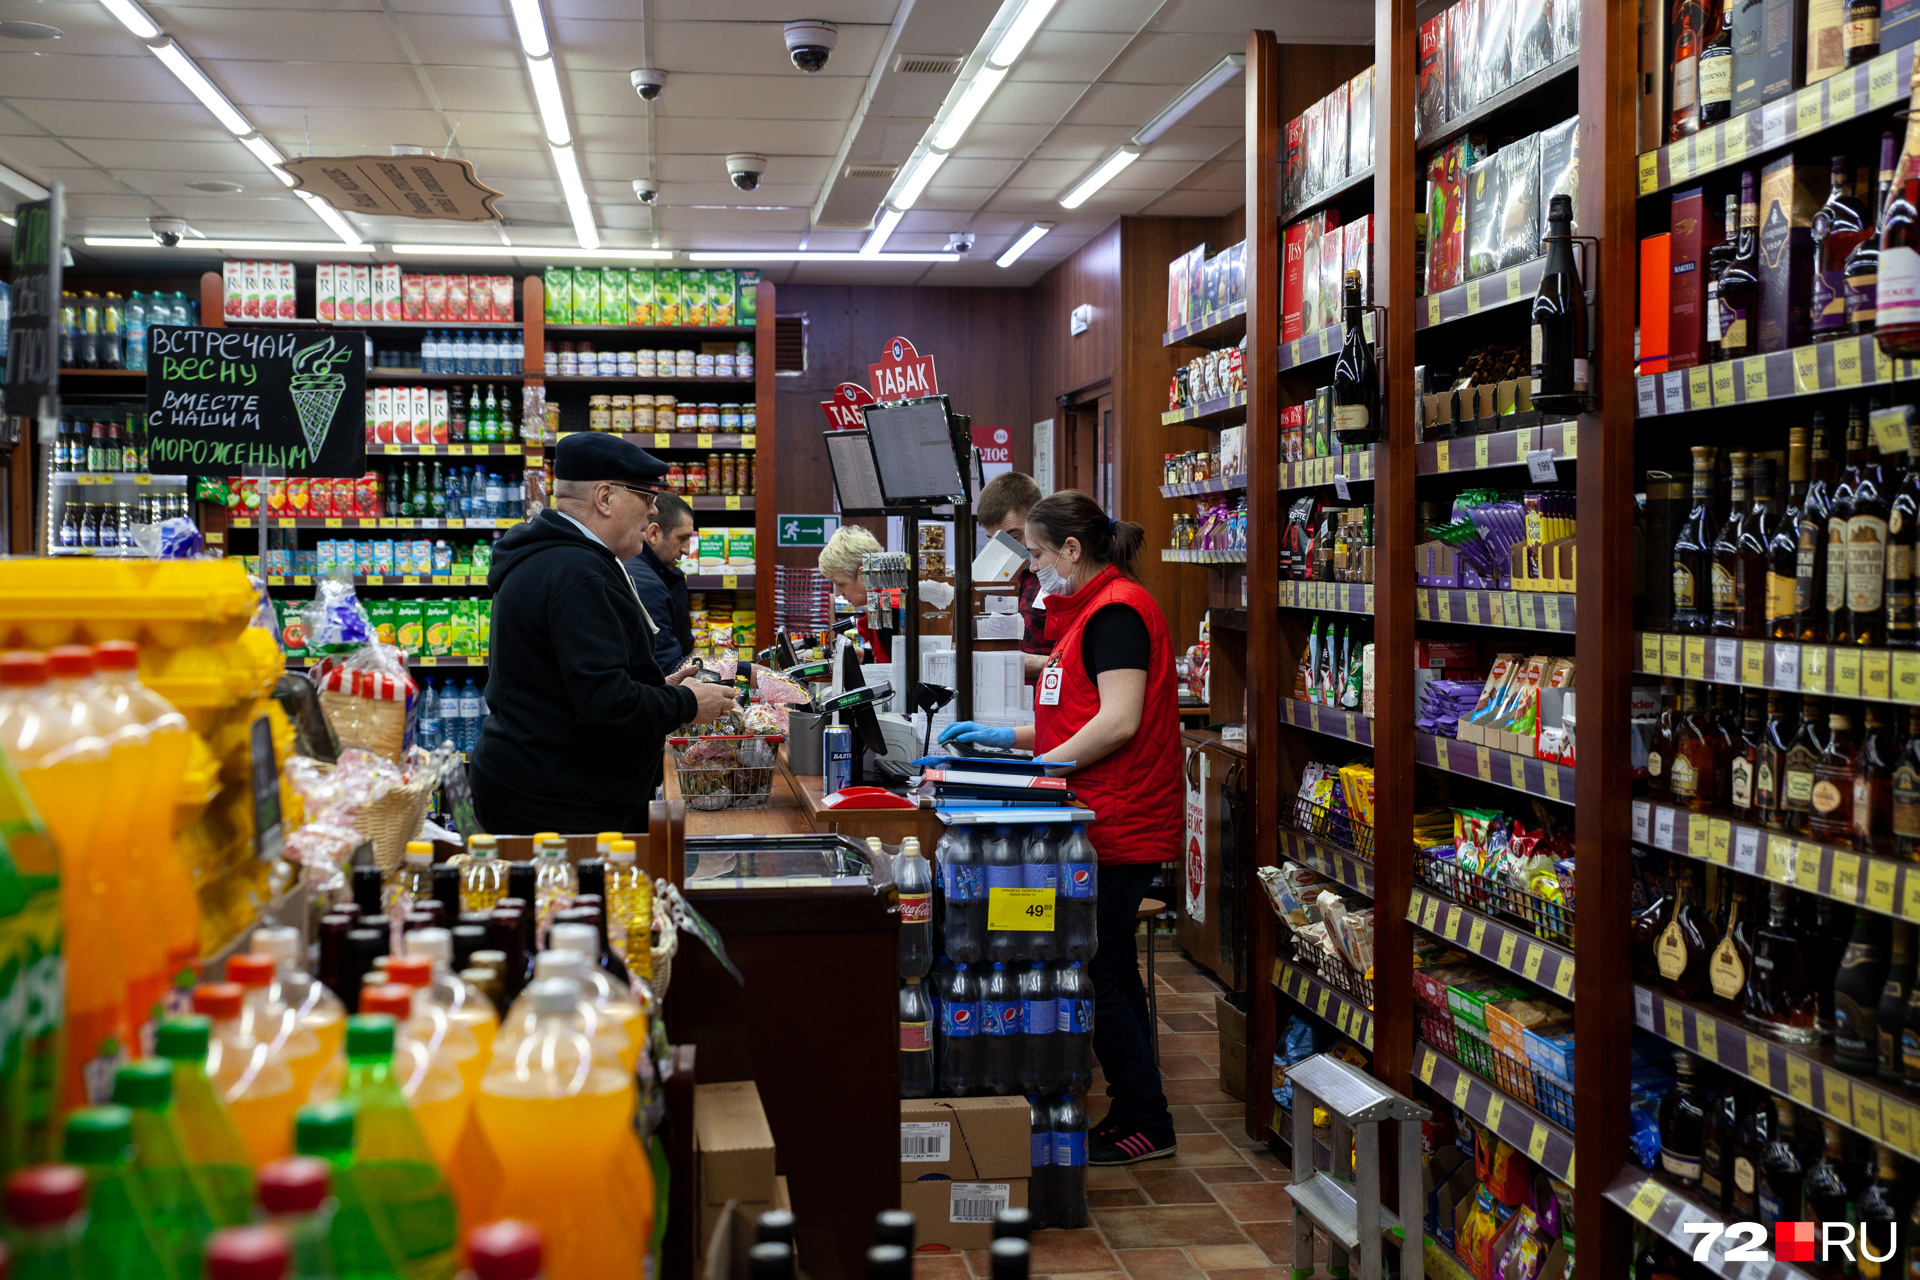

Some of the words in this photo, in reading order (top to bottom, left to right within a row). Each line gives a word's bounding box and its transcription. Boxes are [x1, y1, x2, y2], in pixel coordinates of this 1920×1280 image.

[1423, 26, 1437, 53] TESS
[1288, 126, 1300, 145] TESS
[1288, 238, 1302, 263] TESS
[1673, 262, 1695, 274] MARTELL
[875, 363, 930, 396] ТАБАК
[162, 390, 259, 411] ВМЕСТЕ
[149, 410, 163, 426] С
[171, 411, 260, 430] НАШИМ
[830, 402, 865, 427] ТАБ
[151, 436, 307, 470] МОРОЖЕНЫМ
[1527, 517, 1541, 532] Alpen
[1529, 529, 1541, 540] Gold
[1631, 700, 1656, 709] nder
[836, 775, 846, 790] 7
[1026, 904, 1044, 917] 49
